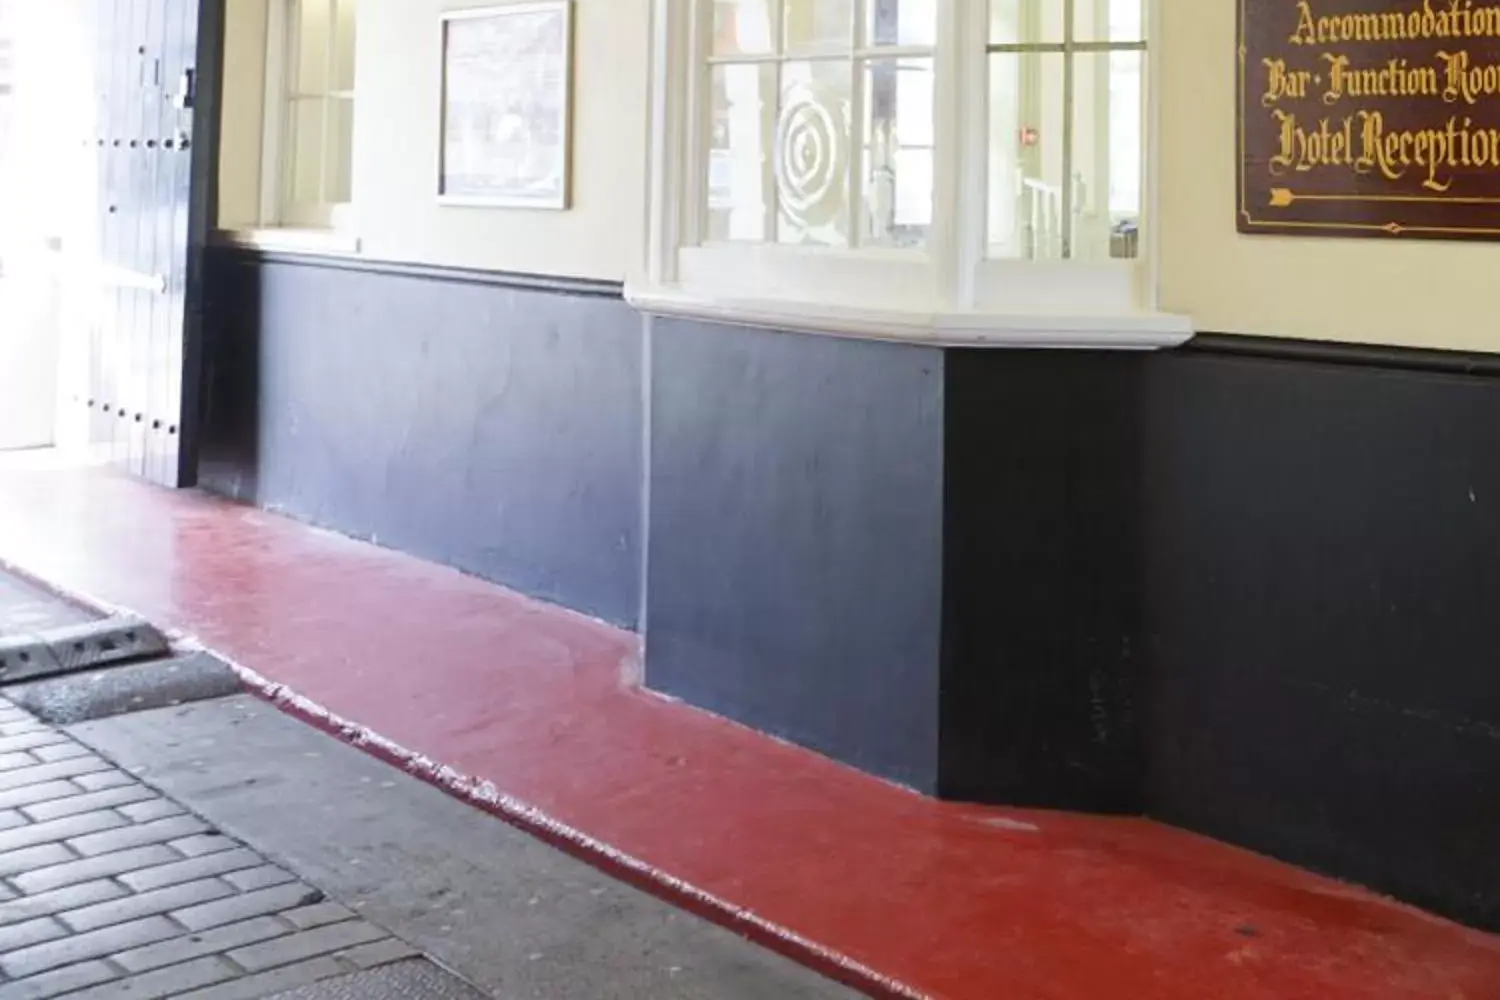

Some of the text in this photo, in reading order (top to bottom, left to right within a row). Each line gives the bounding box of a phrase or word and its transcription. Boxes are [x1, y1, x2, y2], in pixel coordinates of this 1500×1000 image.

[1262, 57, 1311, 107] Bar
[1322, 52, 1437, 105] Function
[1269, 109, 1353, 175] Hotel
